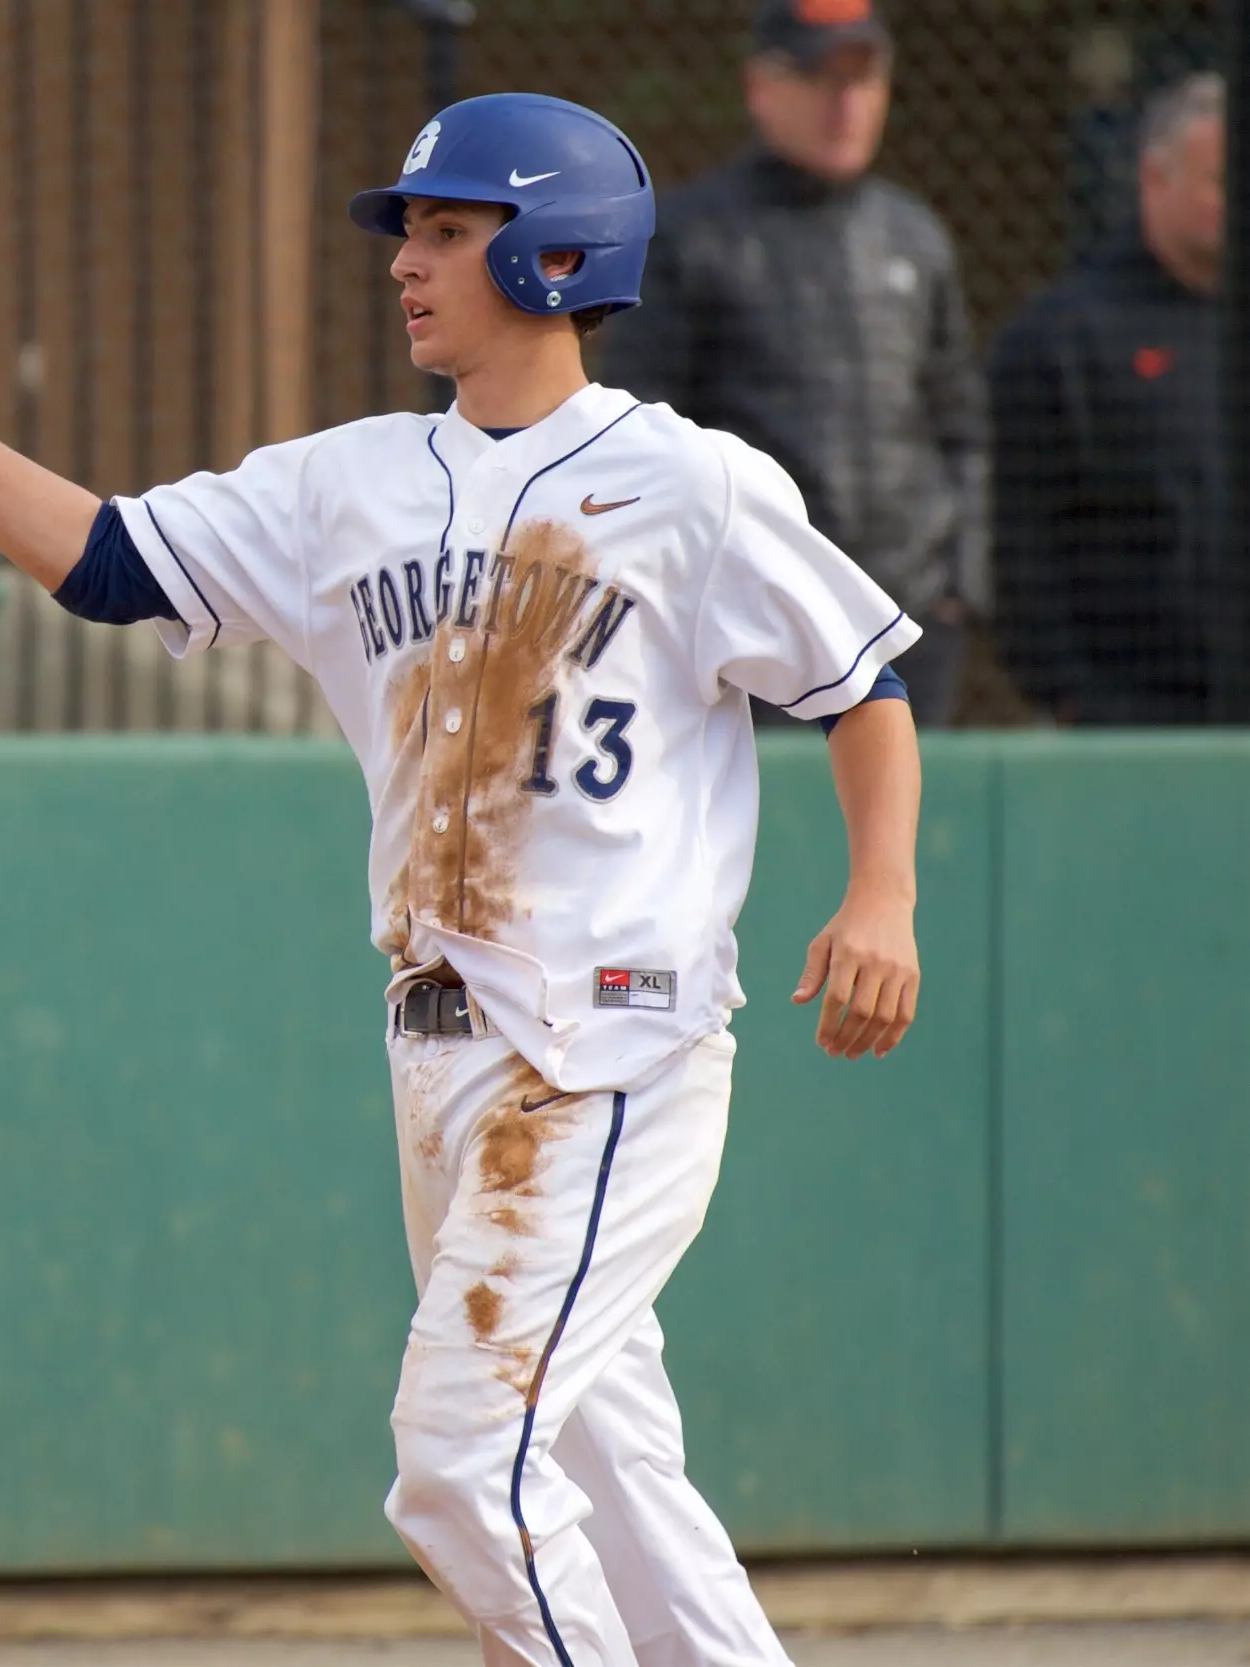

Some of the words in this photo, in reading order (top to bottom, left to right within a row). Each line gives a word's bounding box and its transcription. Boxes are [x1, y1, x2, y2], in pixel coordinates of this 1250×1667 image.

[350, 549, 635, 669] EORGETOWN
[517, 688, 637, 803] 13
[639, 974, 661, 989] XL
